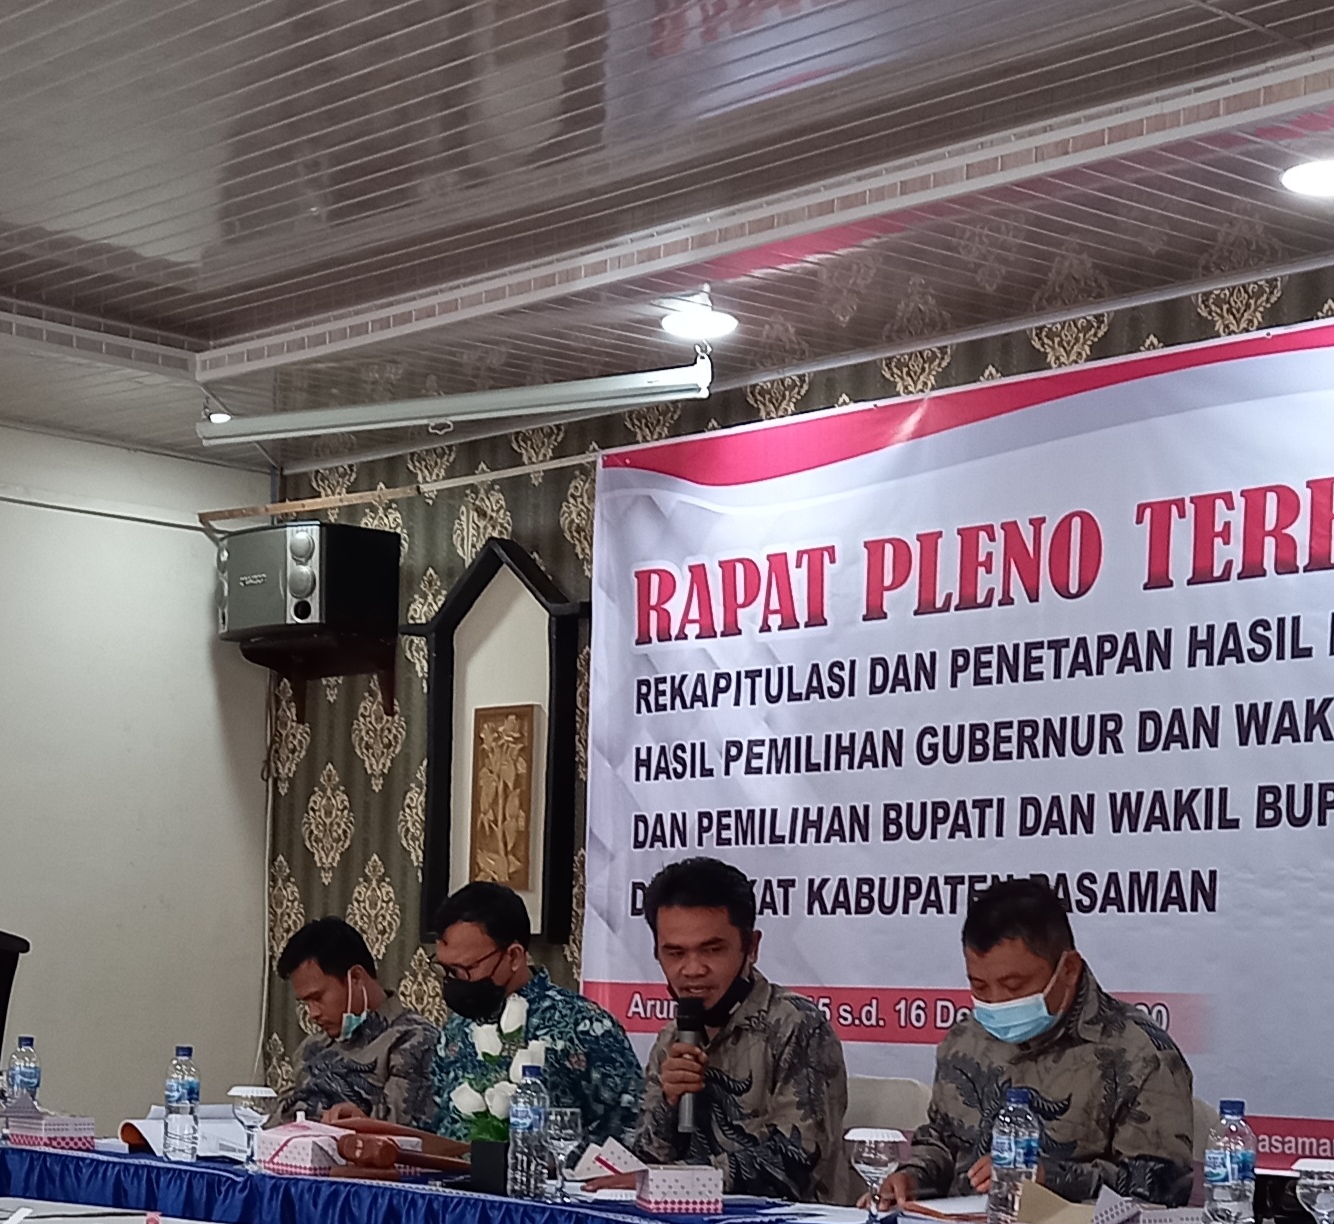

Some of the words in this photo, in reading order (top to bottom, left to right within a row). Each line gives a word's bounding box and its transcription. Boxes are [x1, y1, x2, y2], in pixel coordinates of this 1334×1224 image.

[634, 545, 836, 646] RAPAT
[862, 509, 1103, 623] PLENO
[635, 658, 856, 714] REKAPITULASI
[869, 651, 937, 696] DAN
[950, 629, 1172, 688] PENETAPAN
[1187, 616, 1313, 668] HASIL
[634, 739, 714, 783] HASIL
[724, 729, 903, 776] PEMILIHAN
[916, 712, 1123, 767] GUBERNUR
[1138, 704, 1220, 753] DAN
[632, 811, 687, 849] DAN
[697, 804, 869, 848] PEMILIHAN
[882, 797, 1005, 841] BUPATI
[1019, 793, 1094, 836] DAN
[1109, 786, 1240, 833] WAKIL
[838, 998, 885, 1027] s.d.
[895, 998, 927, 1029] 16
